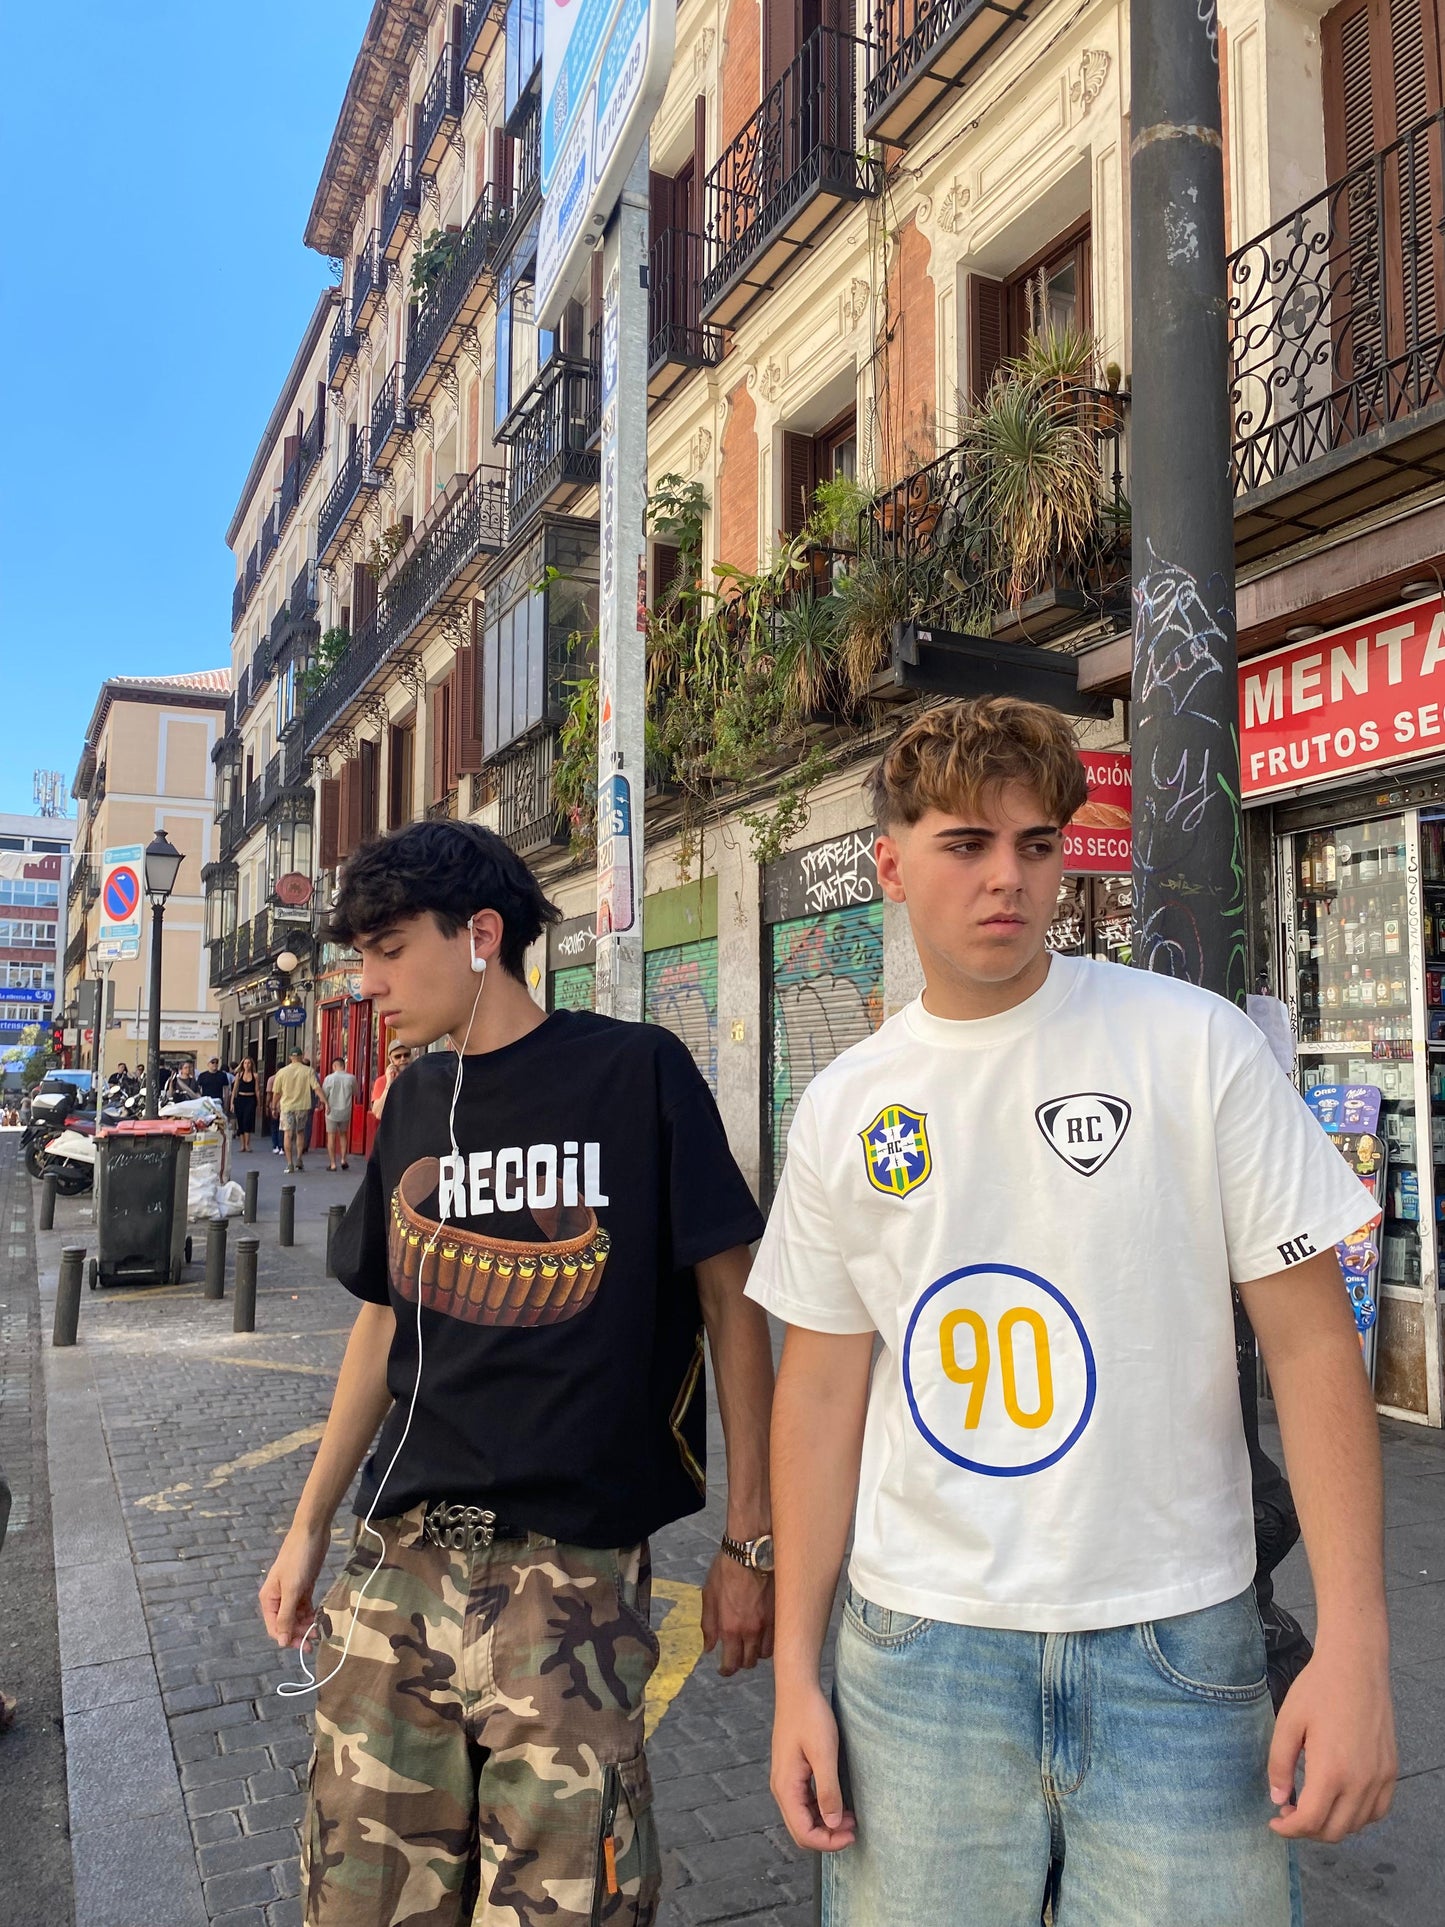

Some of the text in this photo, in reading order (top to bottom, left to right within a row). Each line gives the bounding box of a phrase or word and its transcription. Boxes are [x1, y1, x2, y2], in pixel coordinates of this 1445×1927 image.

[1250, 703, 1445, 781] FRUTOS SE
[1084, 763, 1132, 786] ACIÓN
[1314, 1088, 1337, 1097] OREO
[1067, 1116, 1103, 1143] RC
[887, 1140, 902, 1154] RC
[1277, 1233, 1317, 1265] RC
[939, 1306, 1054, 1430] 90
